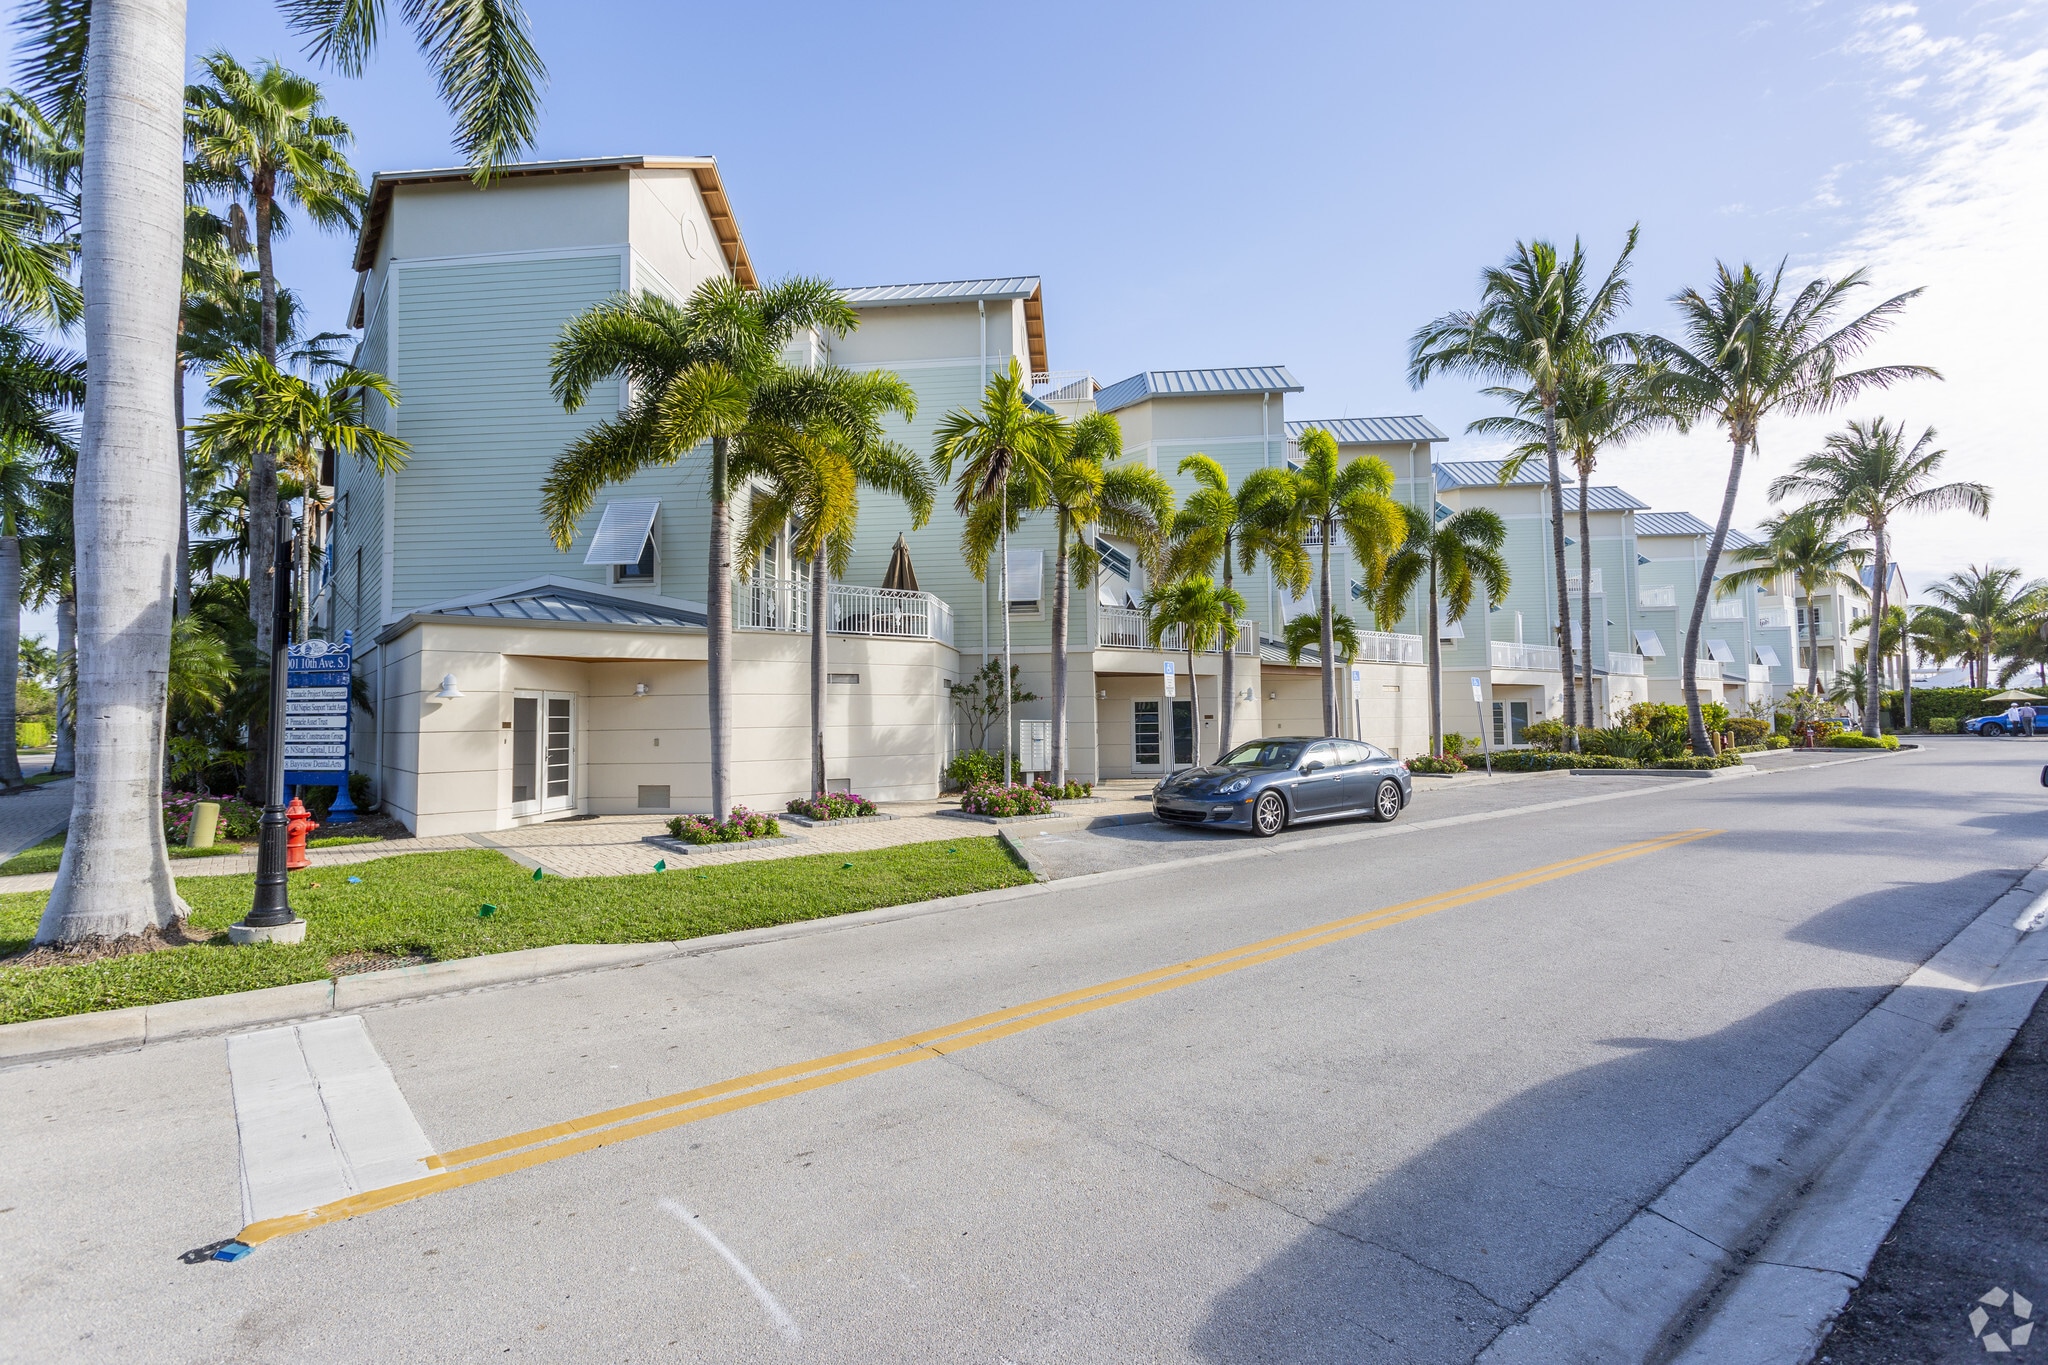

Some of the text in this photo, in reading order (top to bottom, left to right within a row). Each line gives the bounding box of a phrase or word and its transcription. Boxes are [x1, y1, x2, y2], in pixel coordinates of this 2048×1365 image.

[302, 658, 317, 669] 10th
[318, 658, 336, 668] Ave.
[338, 656, 346, 668] S.
[322, 690, 346, 699] Management
[306, 746, 327, 755] Capital,
[290, 760, 312, 769] Bayview
